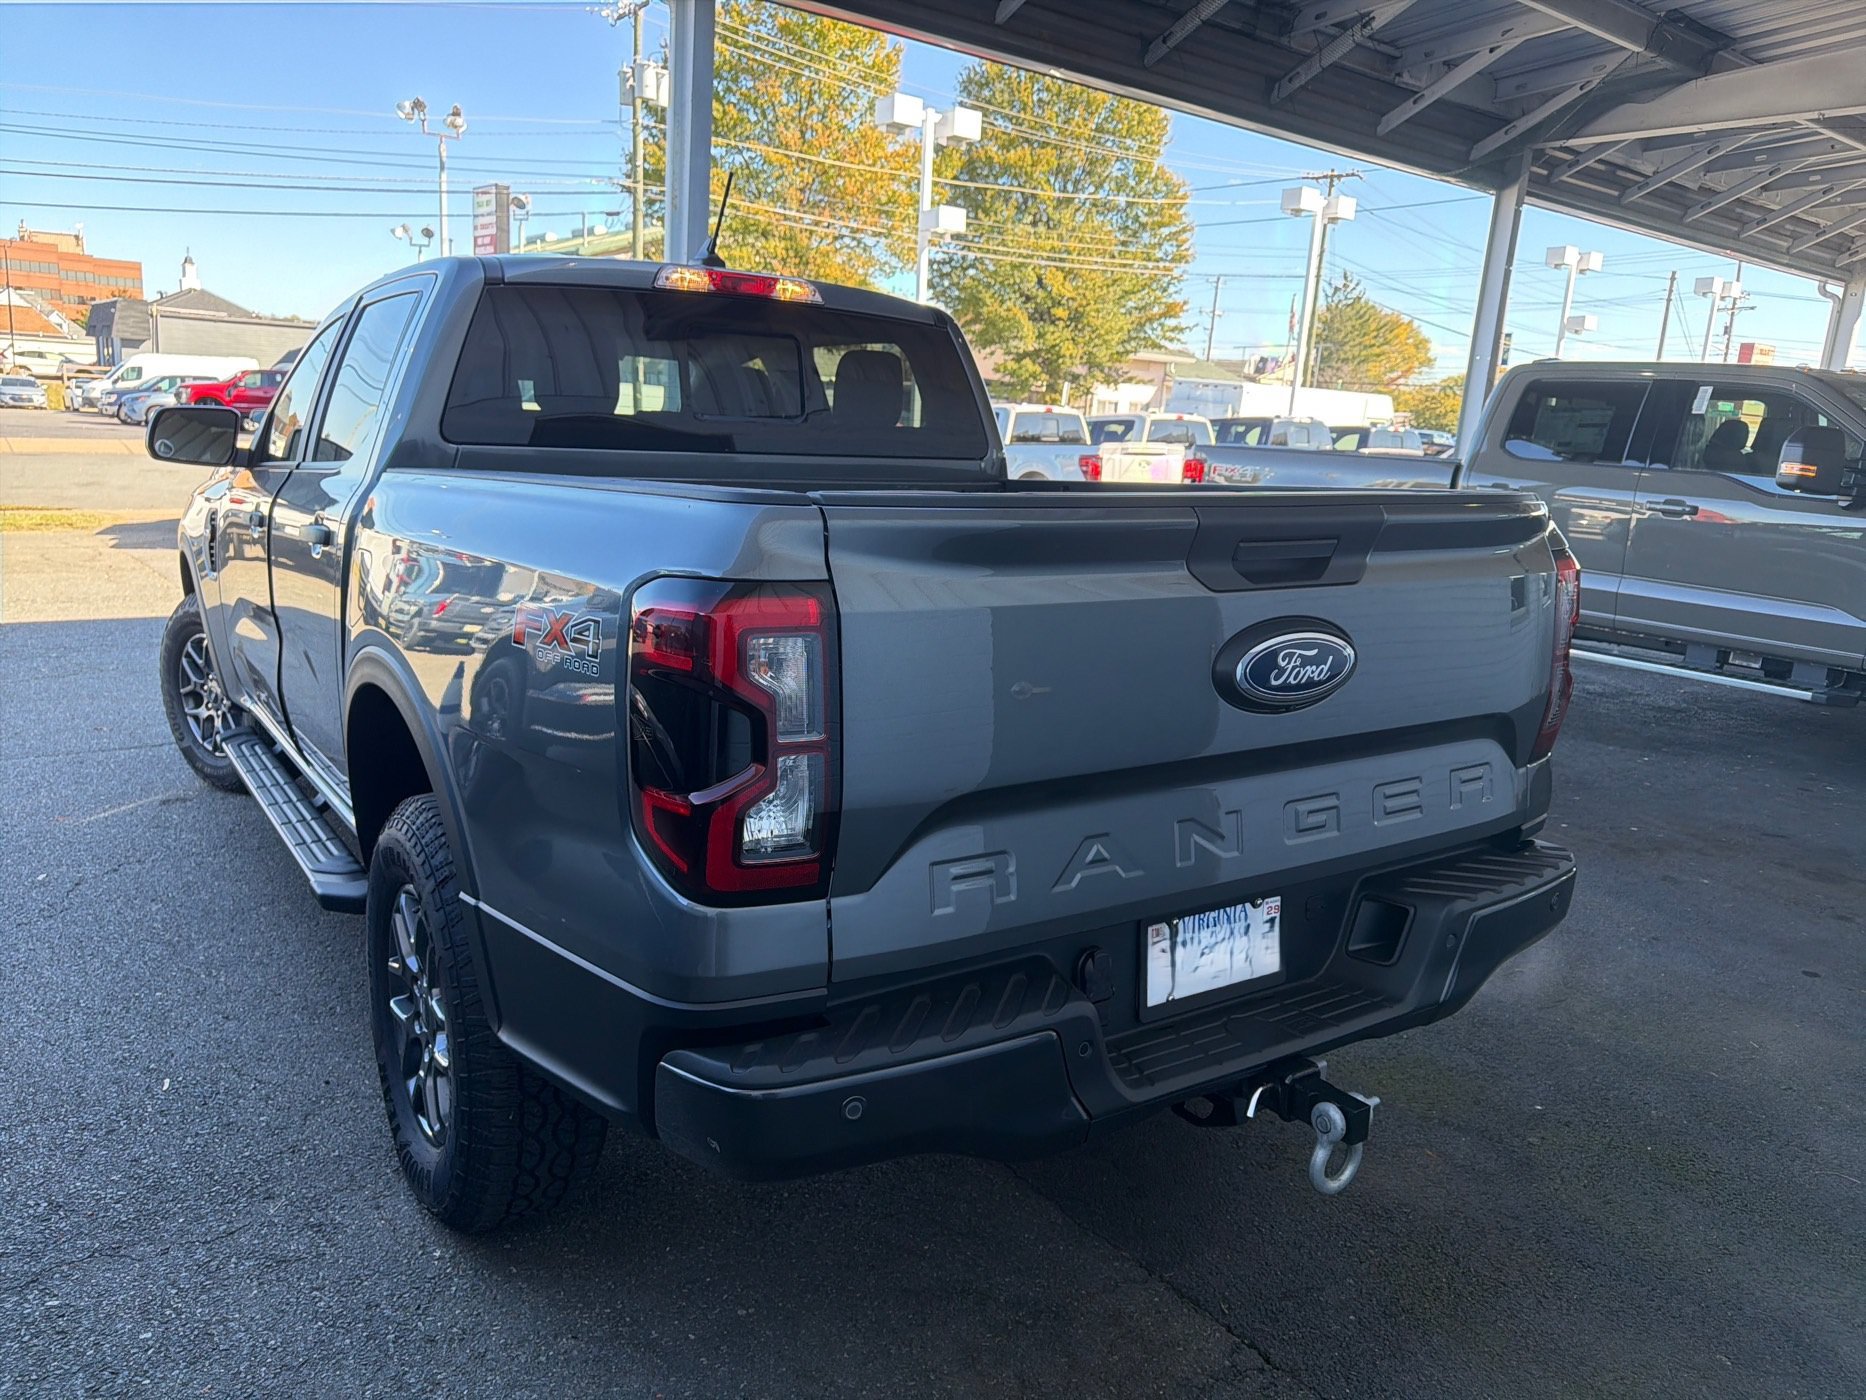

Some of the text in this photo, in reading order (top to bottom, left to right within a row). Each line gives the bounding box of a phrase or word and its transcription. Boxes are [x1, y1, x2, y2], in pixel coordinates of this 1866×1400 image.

[512, 601, 603, 662] FX4
[536, 648, 600, 677] OFF ROAD
[1269, 648, 1334, 686] Ford
[929, 761, 1494, 916] RANGER
[1181, 903, 1249, 934] VIRGINIA
[1266, 904, 1281, 916] 29
